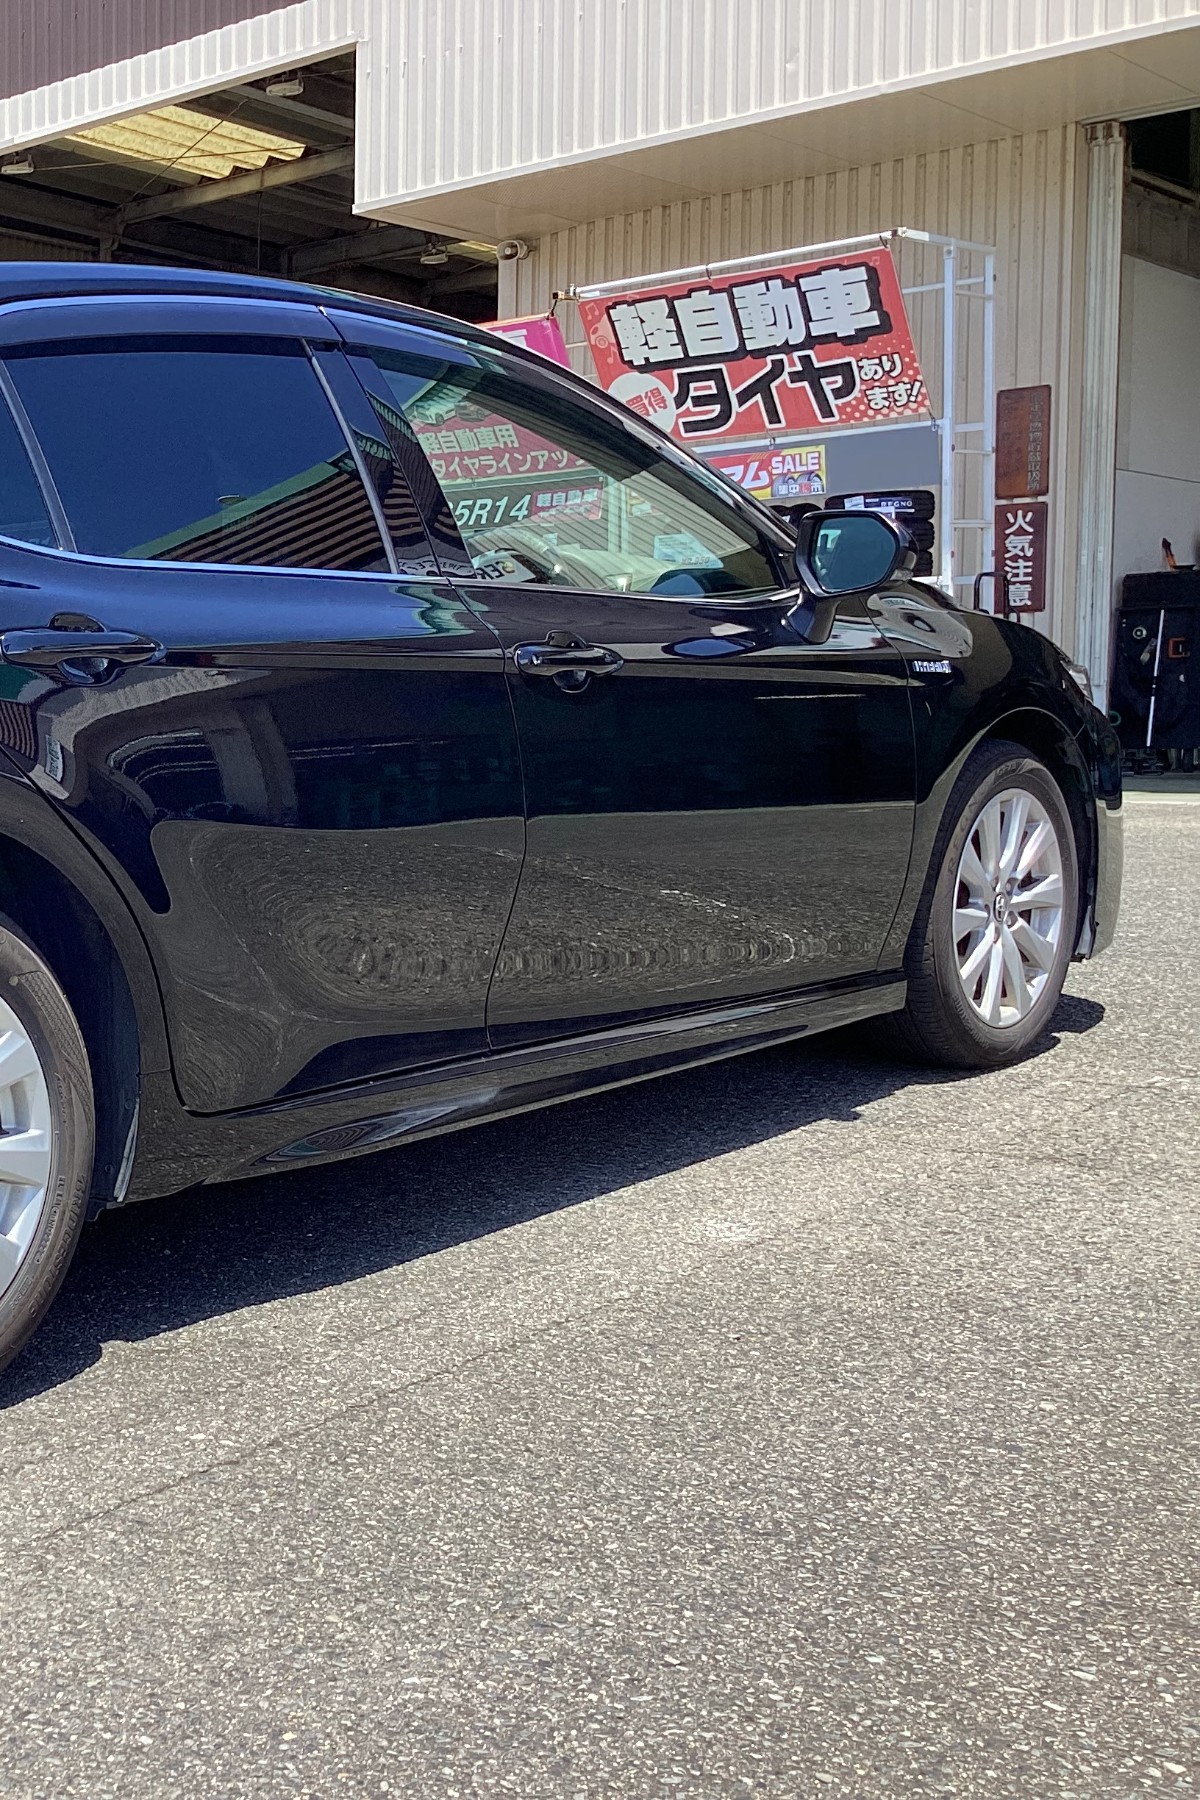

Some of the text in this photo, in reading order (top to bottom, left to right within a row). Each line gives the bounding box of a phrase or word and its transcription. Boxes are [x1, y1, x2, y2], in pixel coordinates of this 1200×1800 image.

[609, 265, 883, 367] 軽自動車
[859, 353, 903, 381] あり
[674, 353, 857, 435] タイヤ
[417, 424, 520, 455] 軽自動車用
[771, 452, 820, 474] SALE
[449, 494, 532, 527] 5R14
[881, 500, 913, 508] REGNO
[1004, 510, 1034, 607] 火気注意
